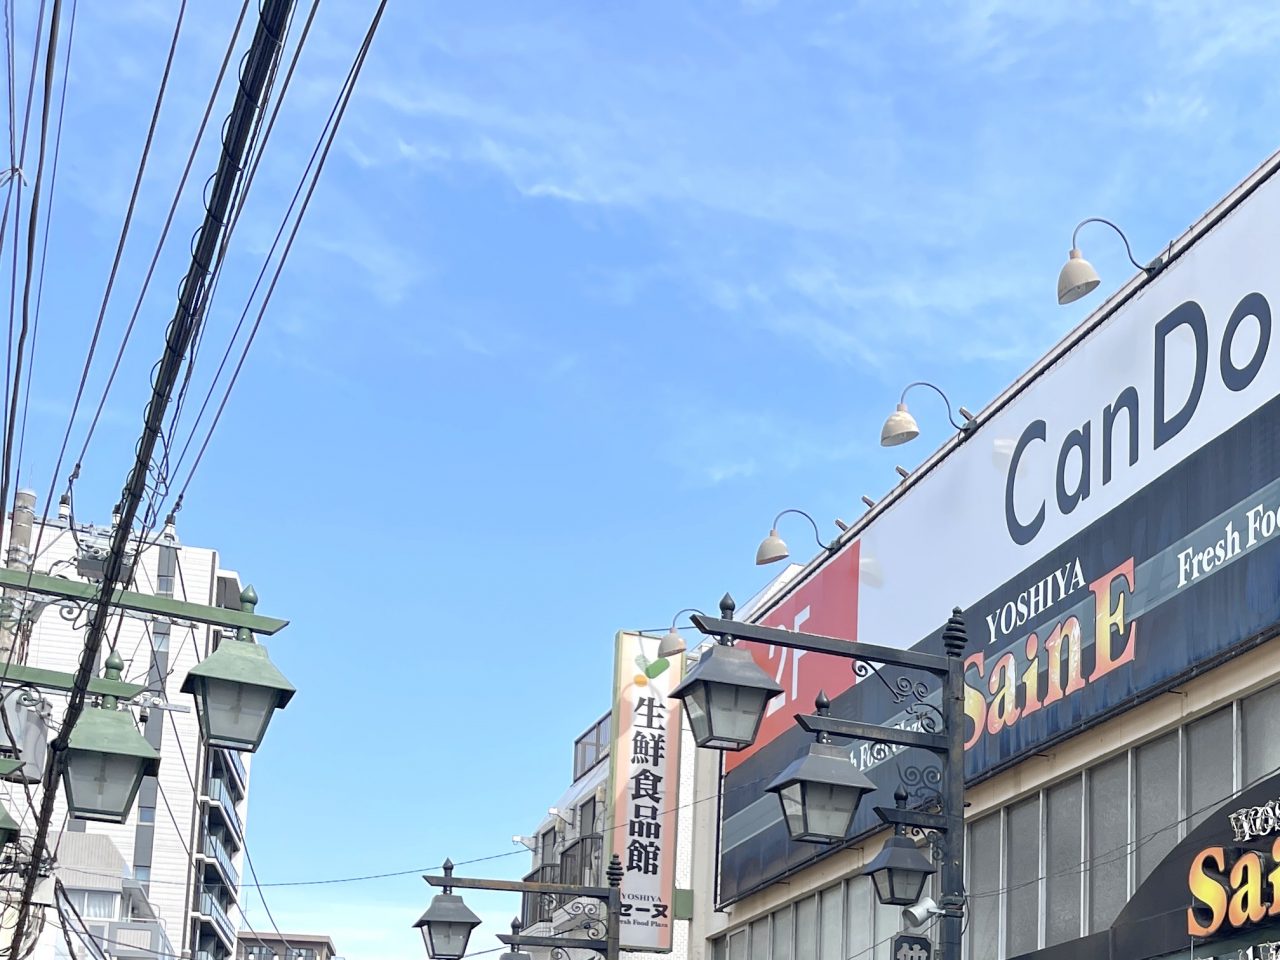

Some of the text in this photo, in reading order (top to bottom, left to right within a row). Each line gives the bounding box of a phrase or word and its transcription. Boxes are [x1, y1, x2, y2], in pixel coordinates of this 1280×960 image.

[1005, 292, 1272, 546] CanDo
[986, 557, 1087, 644] YOSHIYA
[1177, 521, 1239, 589] Fresh
[963, 556, 1135, 751] SainE
[626, 696, 666, 876] 生鮮食品館
[622, 892, 662, 902] YOSHIYA
